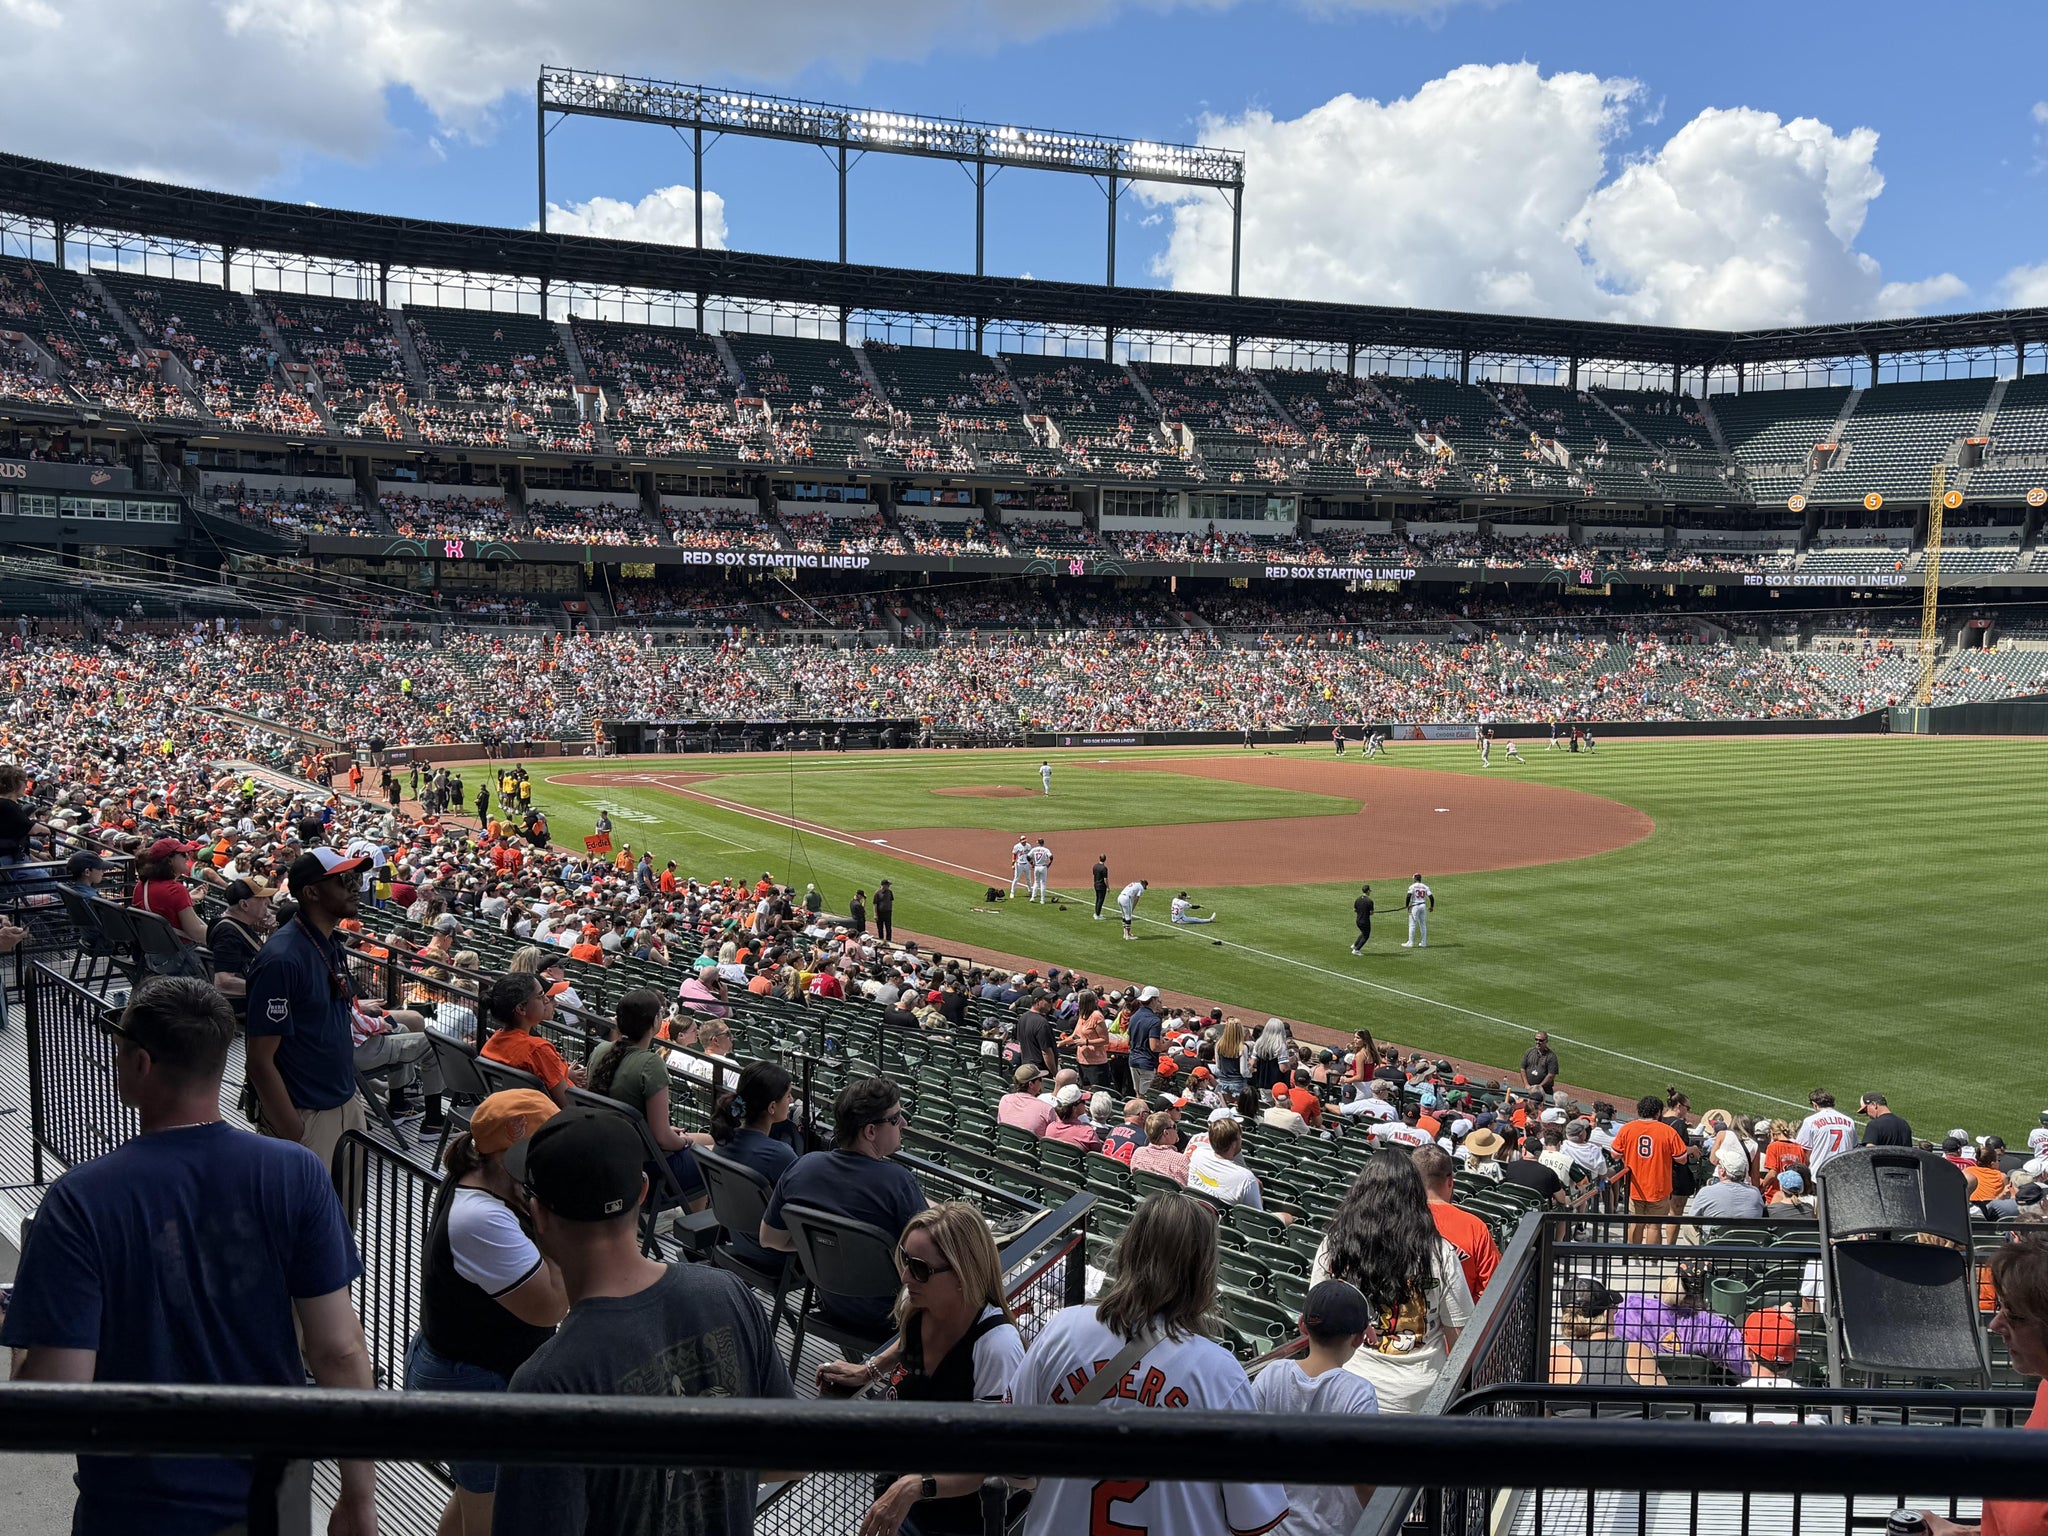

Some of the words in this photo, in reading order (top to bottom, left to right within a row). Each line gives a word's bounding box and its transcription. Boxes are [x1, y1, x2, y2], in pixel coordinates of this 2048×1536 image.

[1791, 499, 1803, 508] 20
[2029, 492, 2044, 502] 22
[683, 551, 711, 565] RED
[715, 552, 745, 566] SOX
[748, 553, 817, 568] STARTING
[821, 556, 870, 569] LINEUP
[1265, 567, 1288, 578] RED
[1290, 567, 1315, 578] SOX
[1317, 568, 1373, 579] STARTING
[1376, 569, 1416, 580] LINEUP
[1743, 575, 1763, 585] RED
[1765, 575, 1791, 585] SOX
[1793, 575, 1856, 586] STARTING
[1860, 575, 1907, 585] LINEUP
[1813, 1116, 1852, 1129] HOLLIDAY
[1394, 1131, 1421, 1147] ALONSO
[1829, 1129, 1843, 1152] 7
[1638, 1135, 1653, 1159] 8
